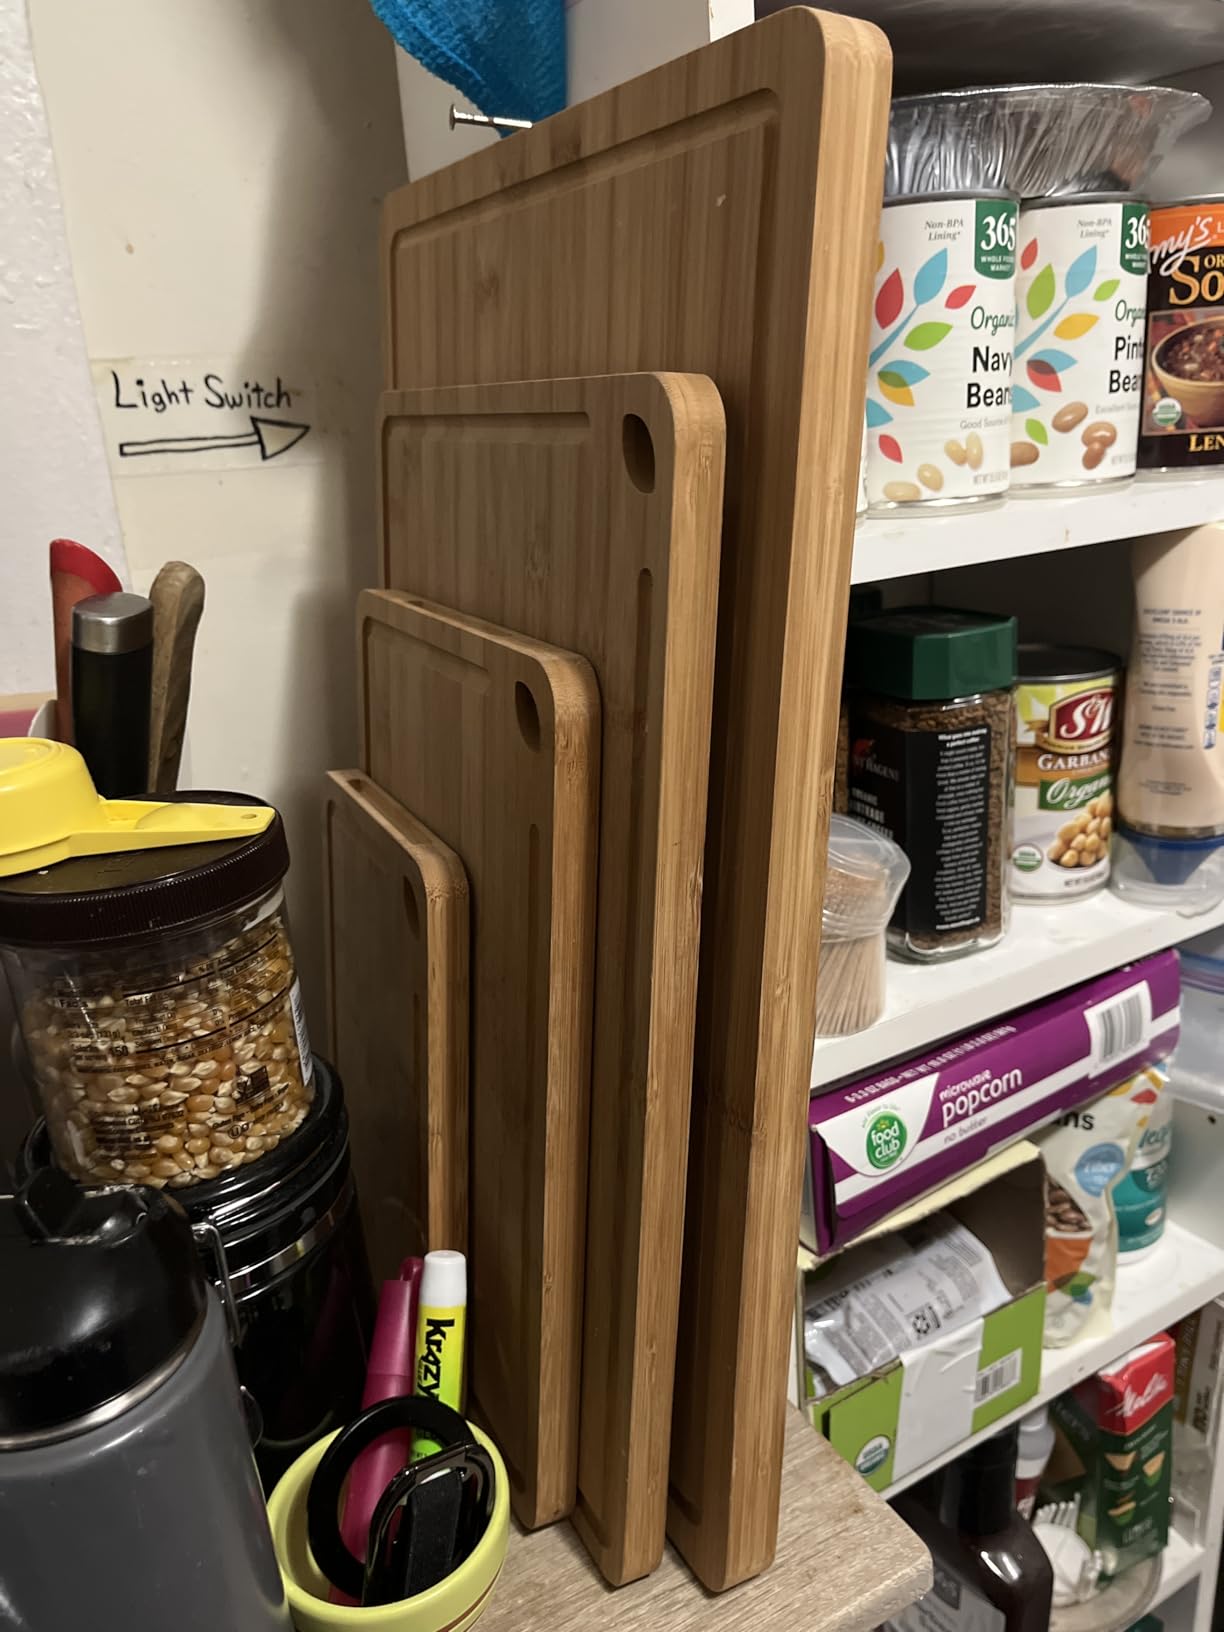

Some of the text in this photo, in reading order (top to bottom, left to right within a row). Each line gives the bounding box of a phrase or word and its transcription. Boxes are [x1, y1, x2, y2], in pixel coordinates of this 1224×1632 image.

[924, 219, 964, 229] Non-BPA
[981, 212, 1015, 251] 365
[1149, 215, 1213, 276] my's
[112, 370, 292, 414] Light Switch
[939, 1069, 992, 1101] microwave
[942, 1068, 1022, 1128] popcorn
[871, 1120, 900, 1147] food
[1053, 1111, 1095, 1131] ns
[875, 1137, 901, 1159] club
